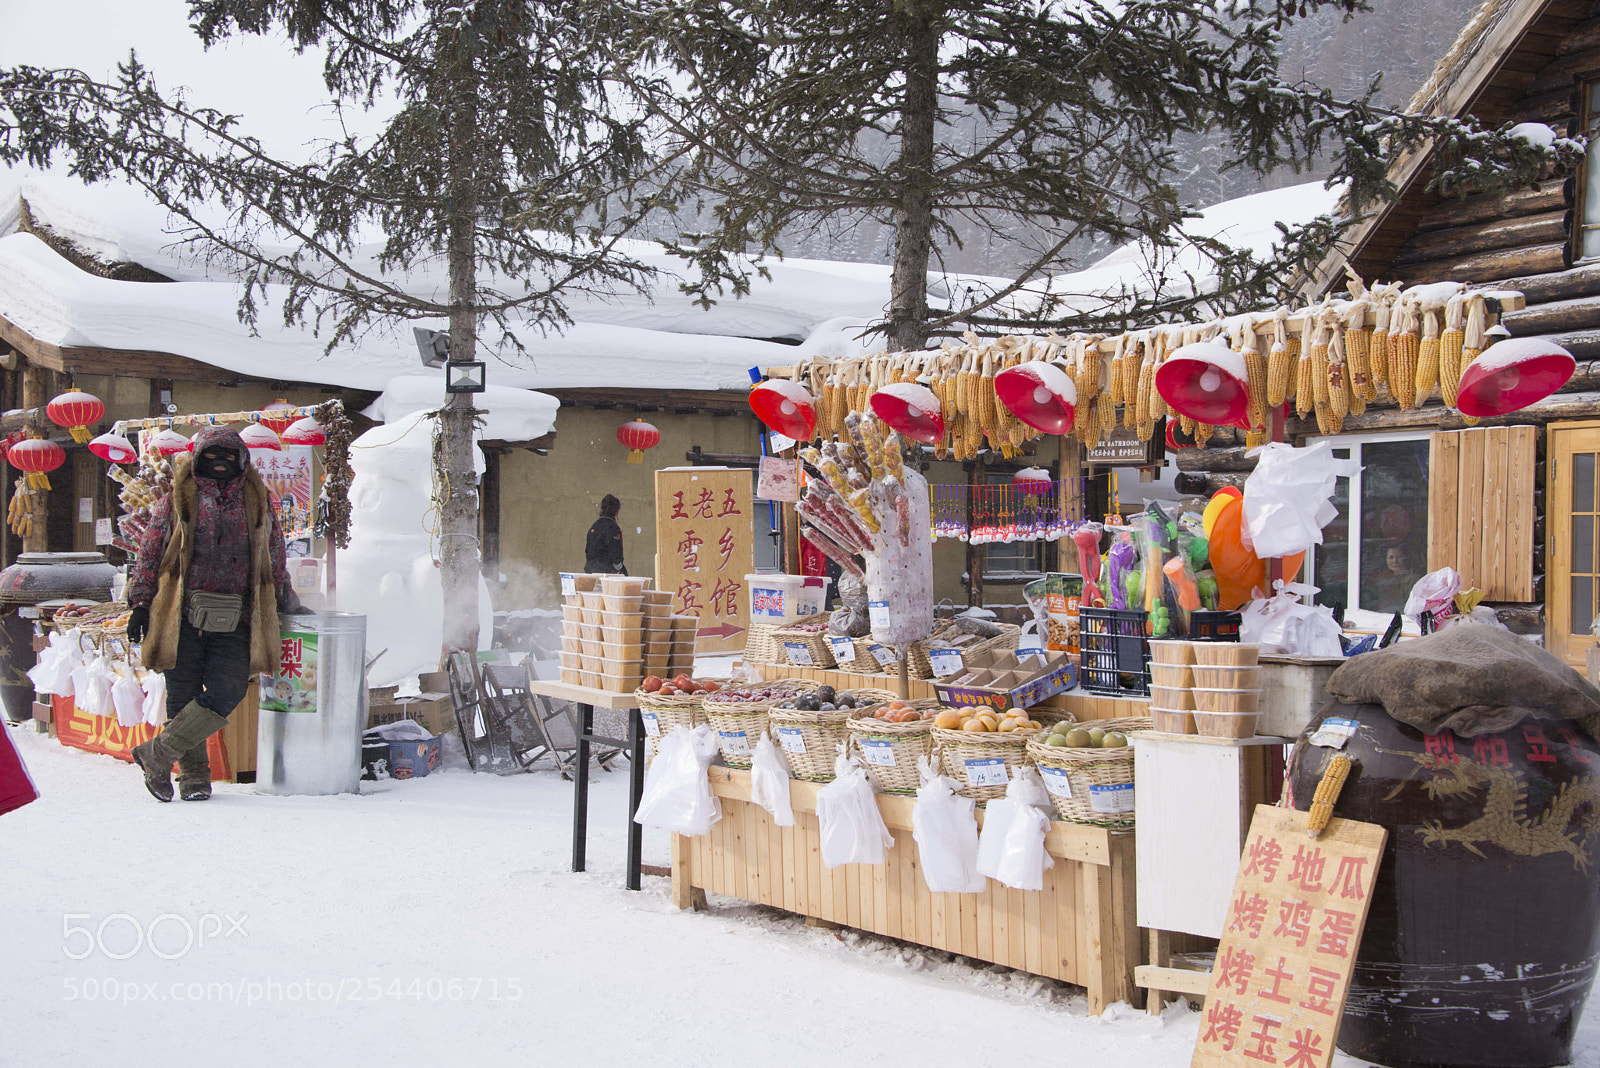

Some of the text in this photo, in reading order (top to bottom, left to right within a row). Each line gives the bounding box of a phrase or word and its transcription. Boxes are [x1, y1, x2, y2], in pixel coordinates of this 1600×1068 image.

[255, 456, 307, 471] 鱼米之乡
[670, 487, 742, 520] 王老五
[677, 527, 735, 572] 雪乡
[675, 578, 741, 618] 宾馆
[1243, 835, 1369, 900] 烤地瓜
[1228, 890, 1357, 958] 烤鸡蛋
[1215, 945, 1340, 1016] 烤土豆
[1202, 999, 1323, 1068] 烤玉米
